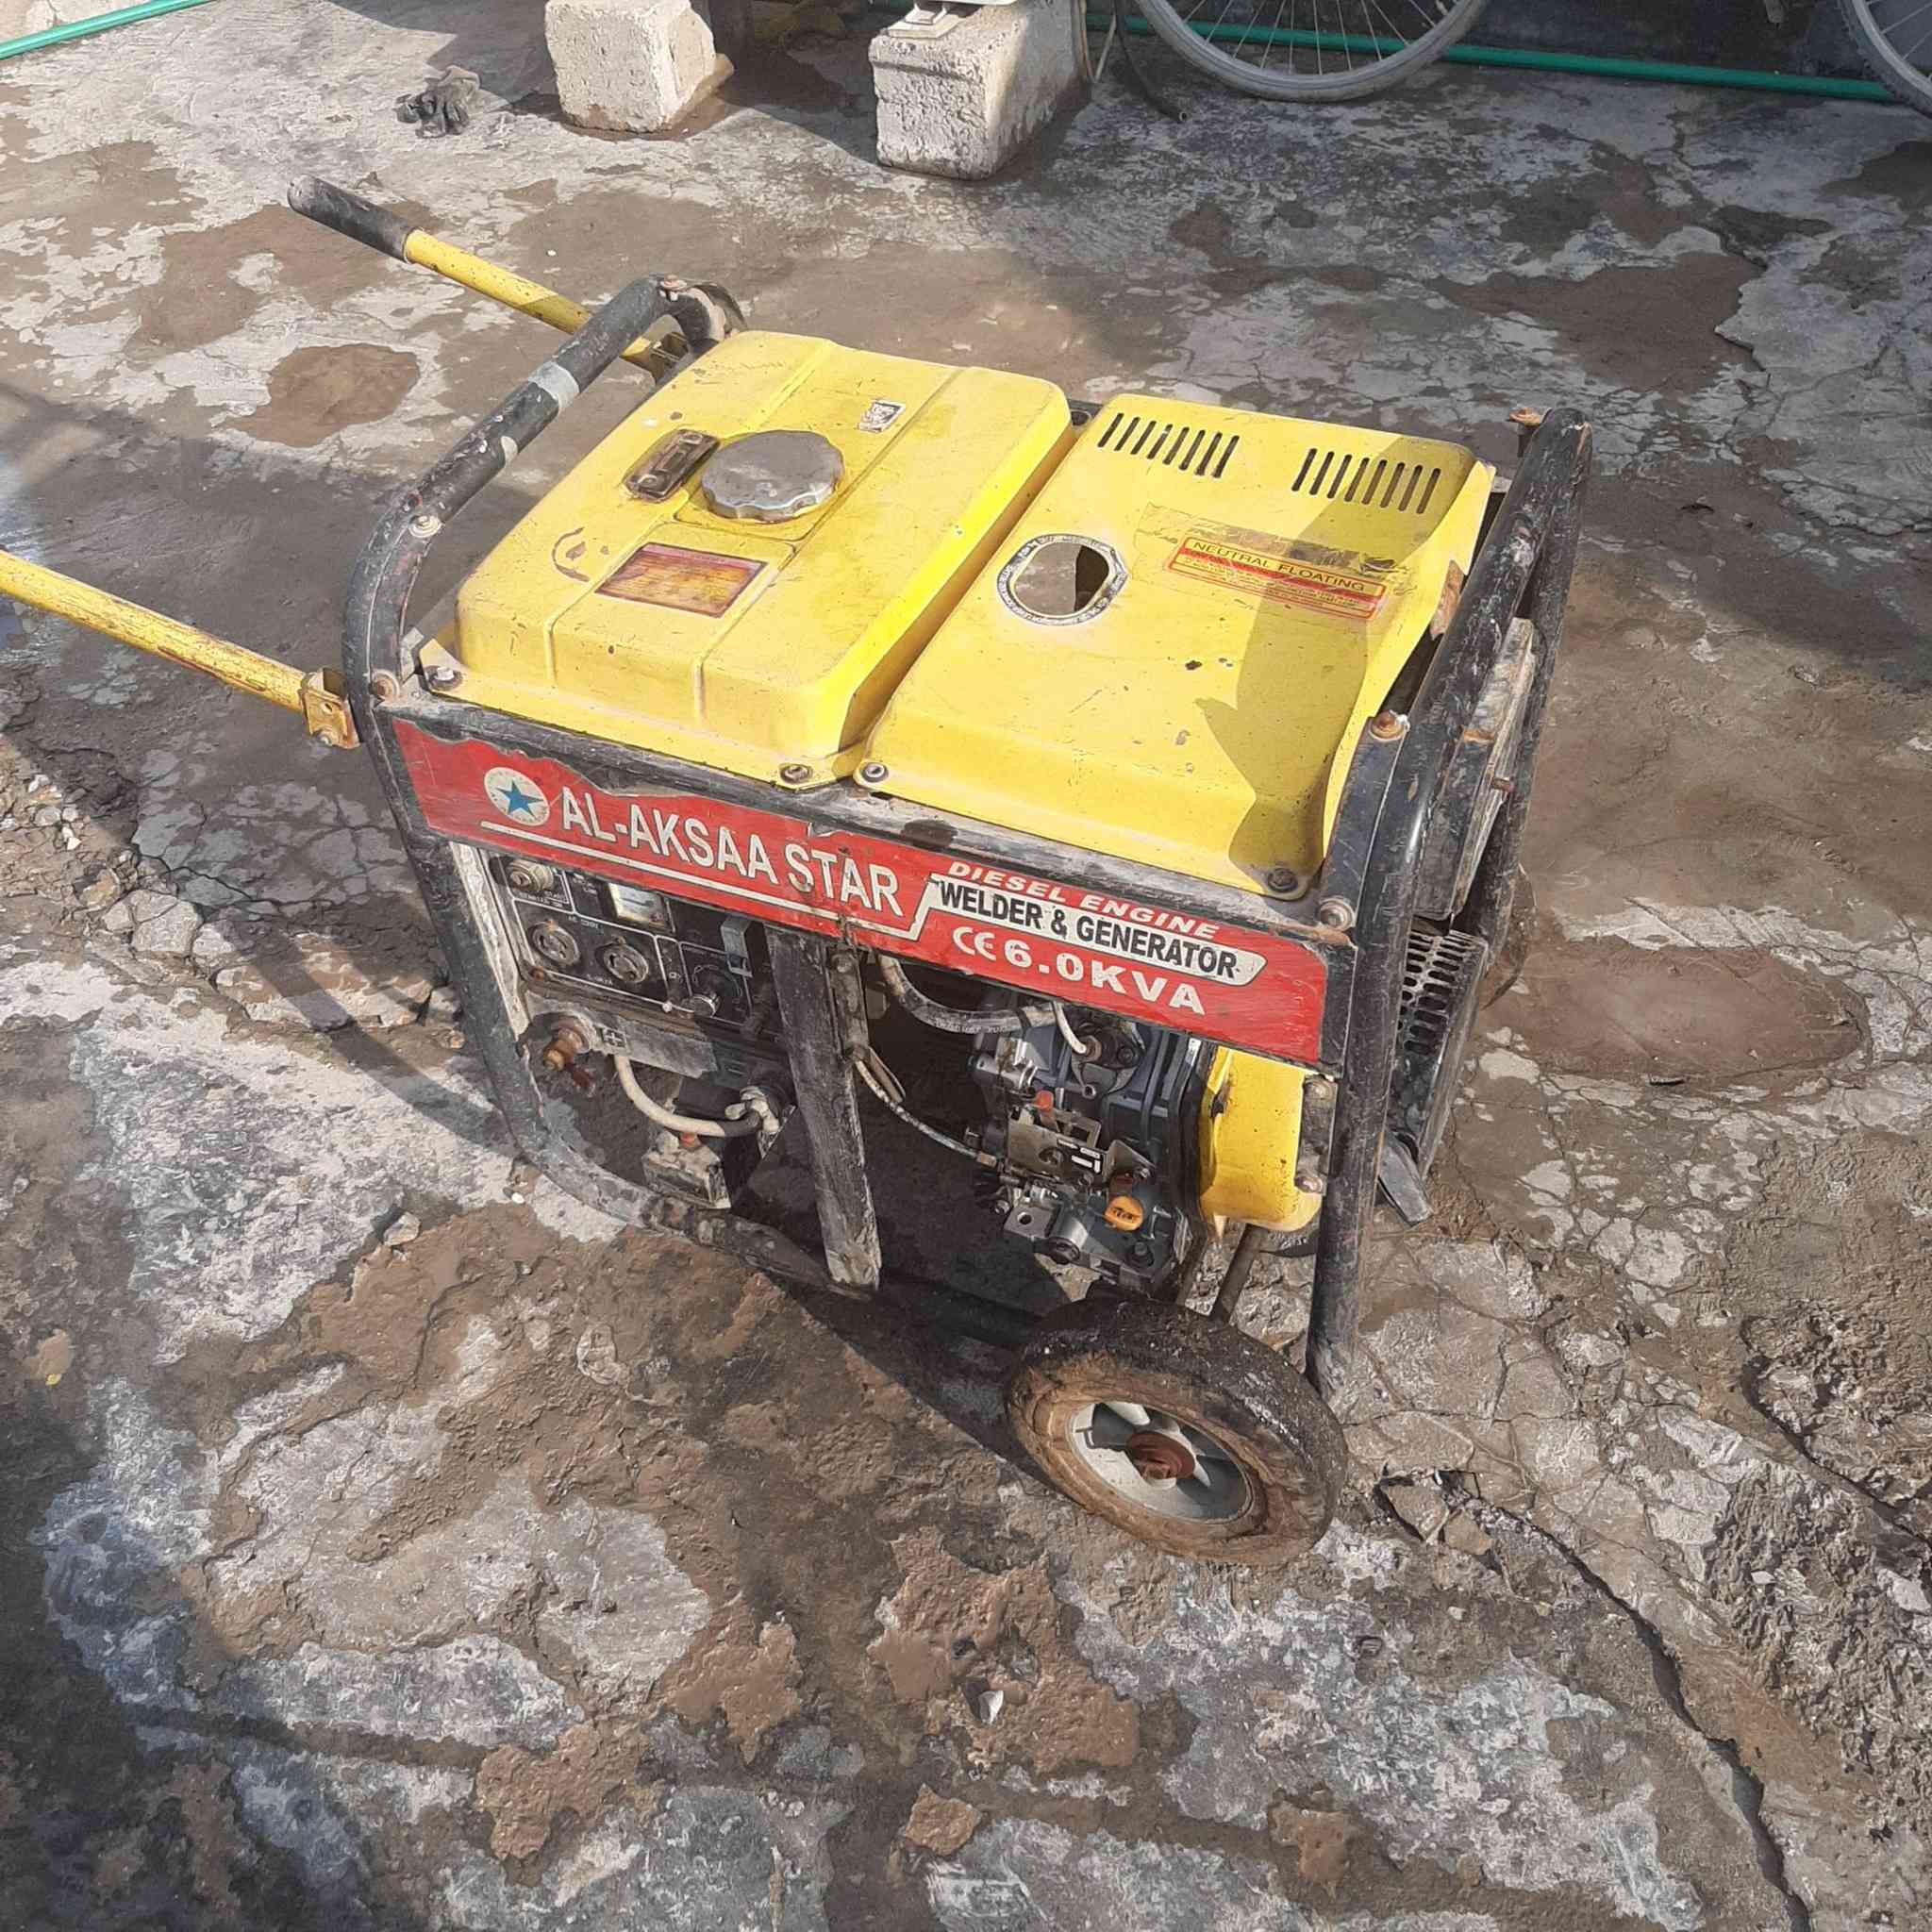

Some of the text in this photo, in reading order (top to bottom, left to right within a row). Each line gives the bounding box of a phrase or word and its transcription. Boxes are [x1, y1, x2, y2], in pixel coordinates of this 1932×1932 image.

[1192, 541, 1270, 568] NEUTRAL
[1277, 564, 1365, 591] FLOATING
[561, 786, 779, 885] AL-AKSAA
[784, 843, 904, 916] STAR
[941, 881, 1238, 979] WELDER & GENERATOR
[947, 861, 1221, 940] DIESEL ENGINE
[1004, 938, 1206, 1016] 6.0KVA
